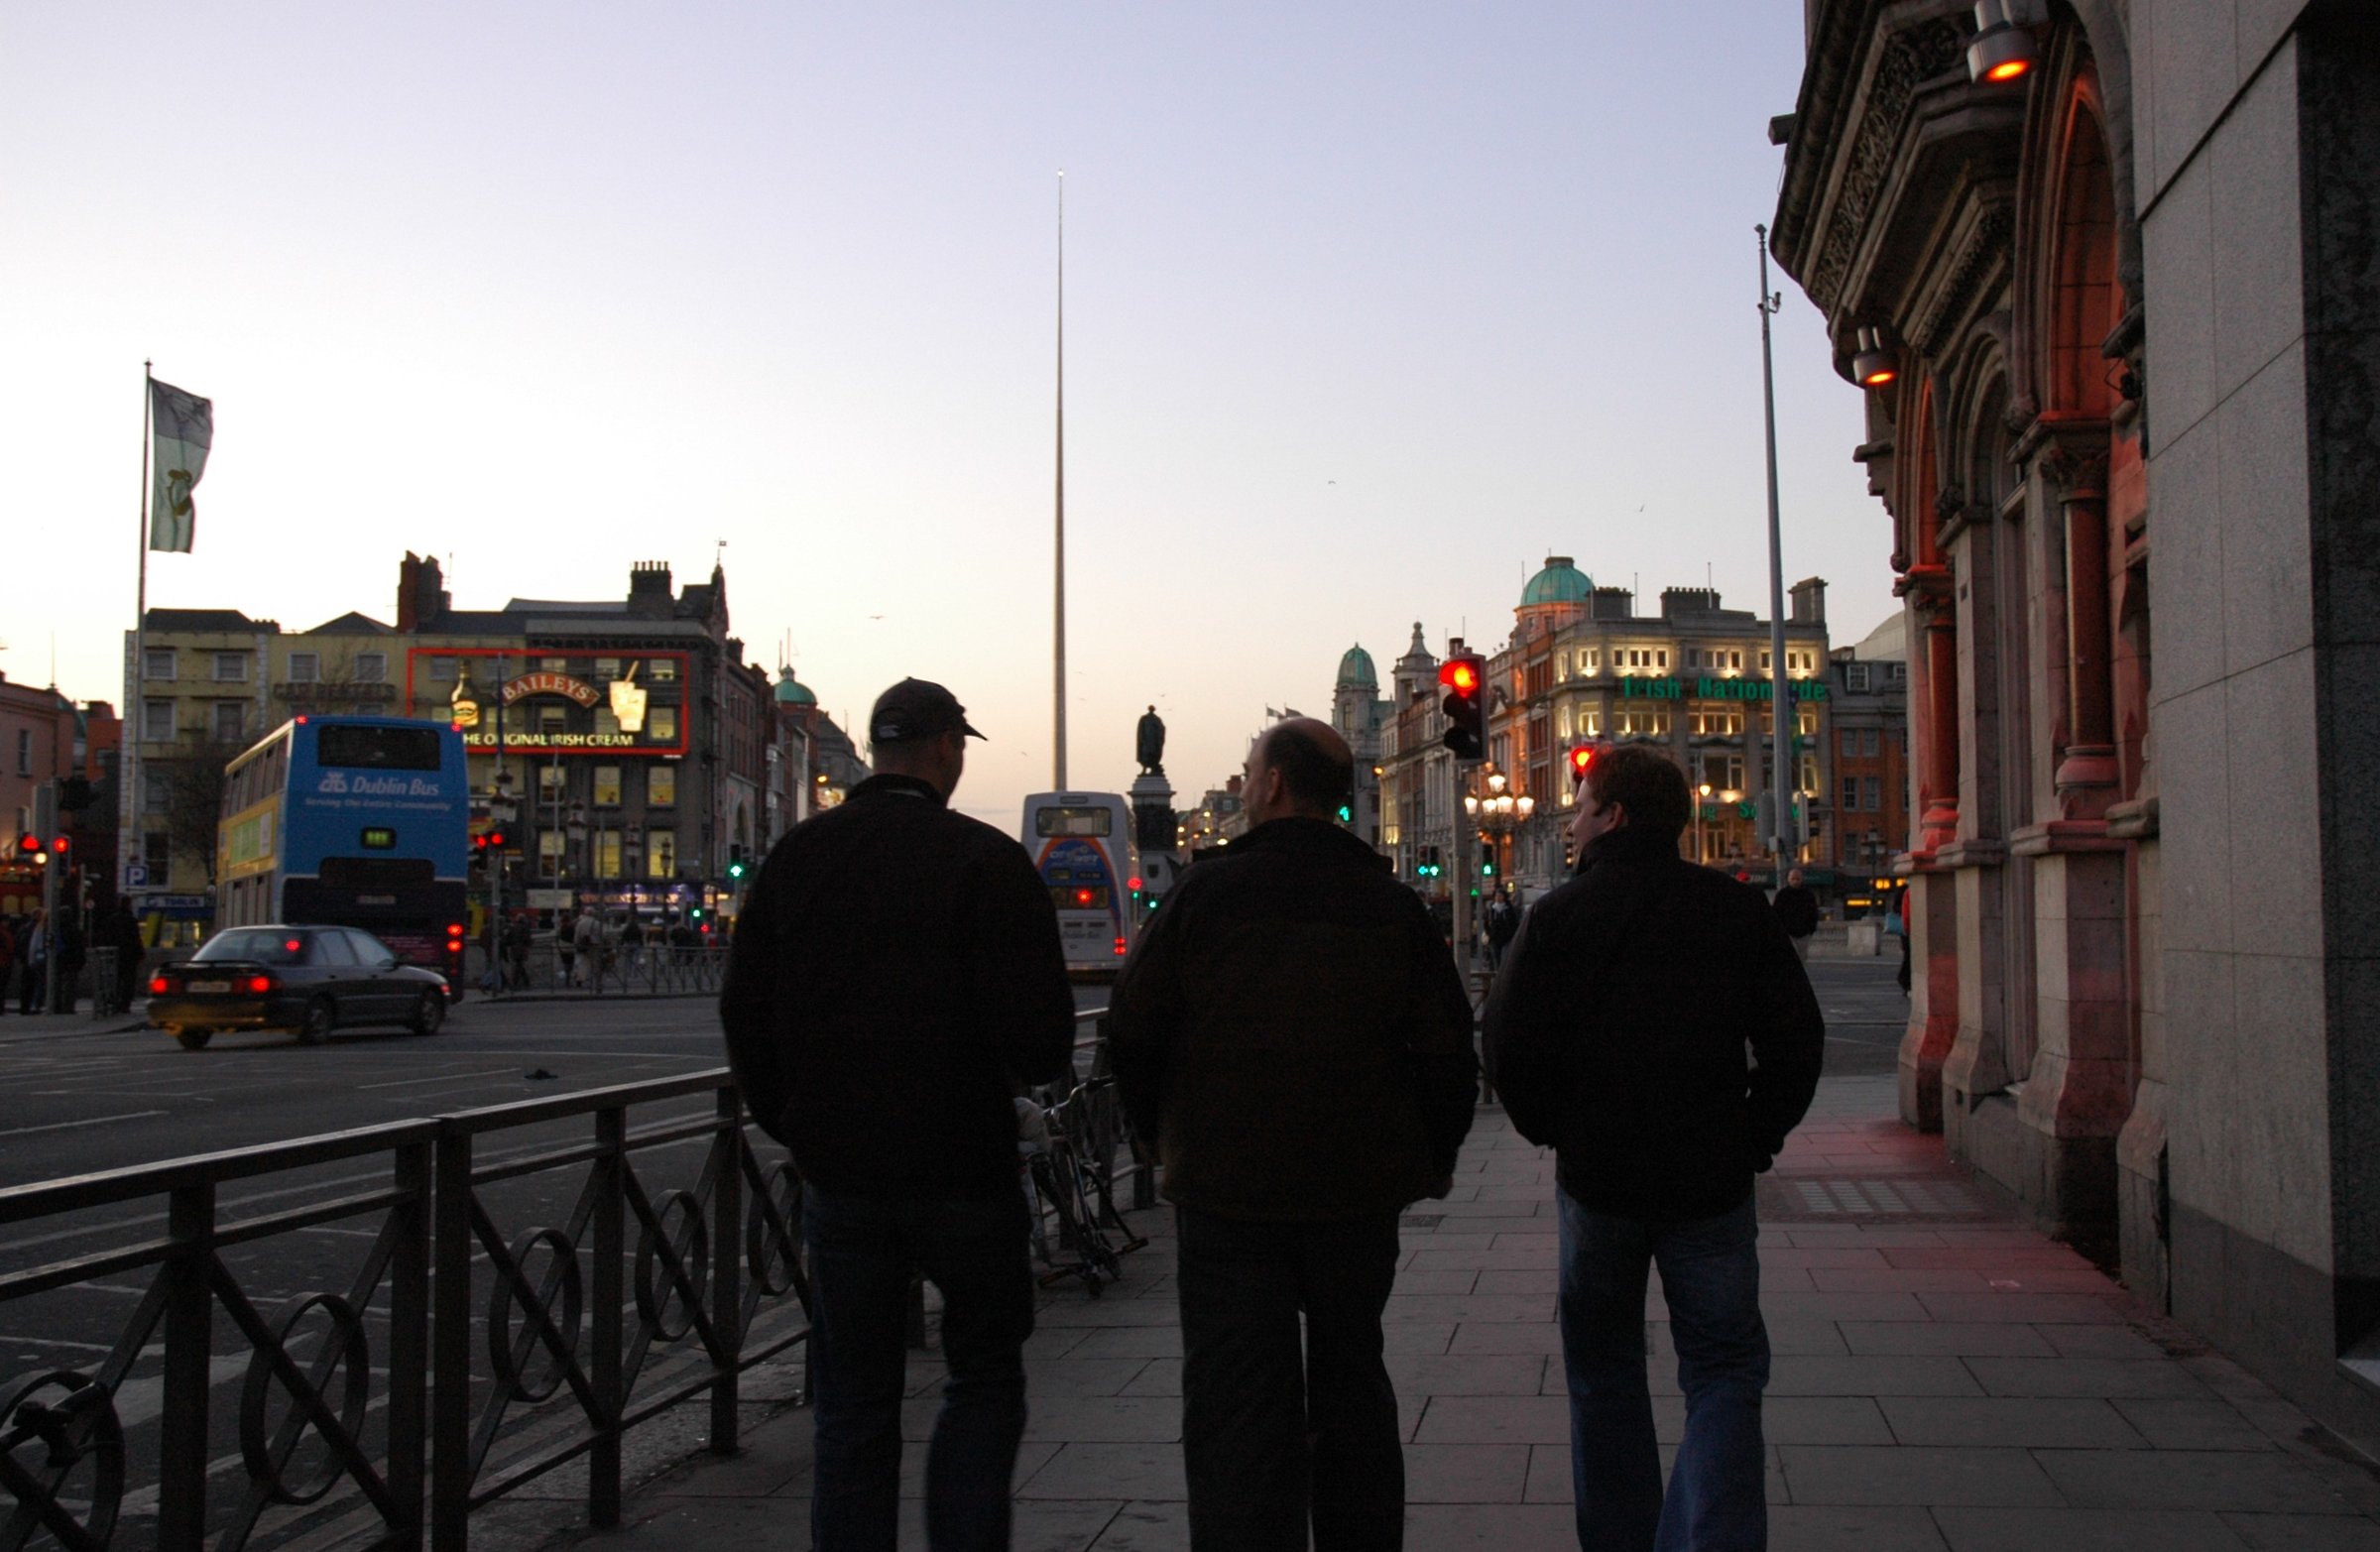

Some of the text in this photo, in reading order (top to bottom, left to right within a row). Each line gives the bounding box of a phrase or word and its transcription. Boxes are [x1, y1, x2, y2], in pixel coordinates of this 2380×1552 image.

[502, 674, 591, 700] BAILEYS
[1623, 675, 1827, 700] Irish Nationide
[483, 733, 547, 746] OIGINAL
[550, 733, 585, 746] IRISH
[586, 733, 634, 746] CREAM
[351, 776, 440, 795] Dublin Bus
[129, 868, 145, 886] P
